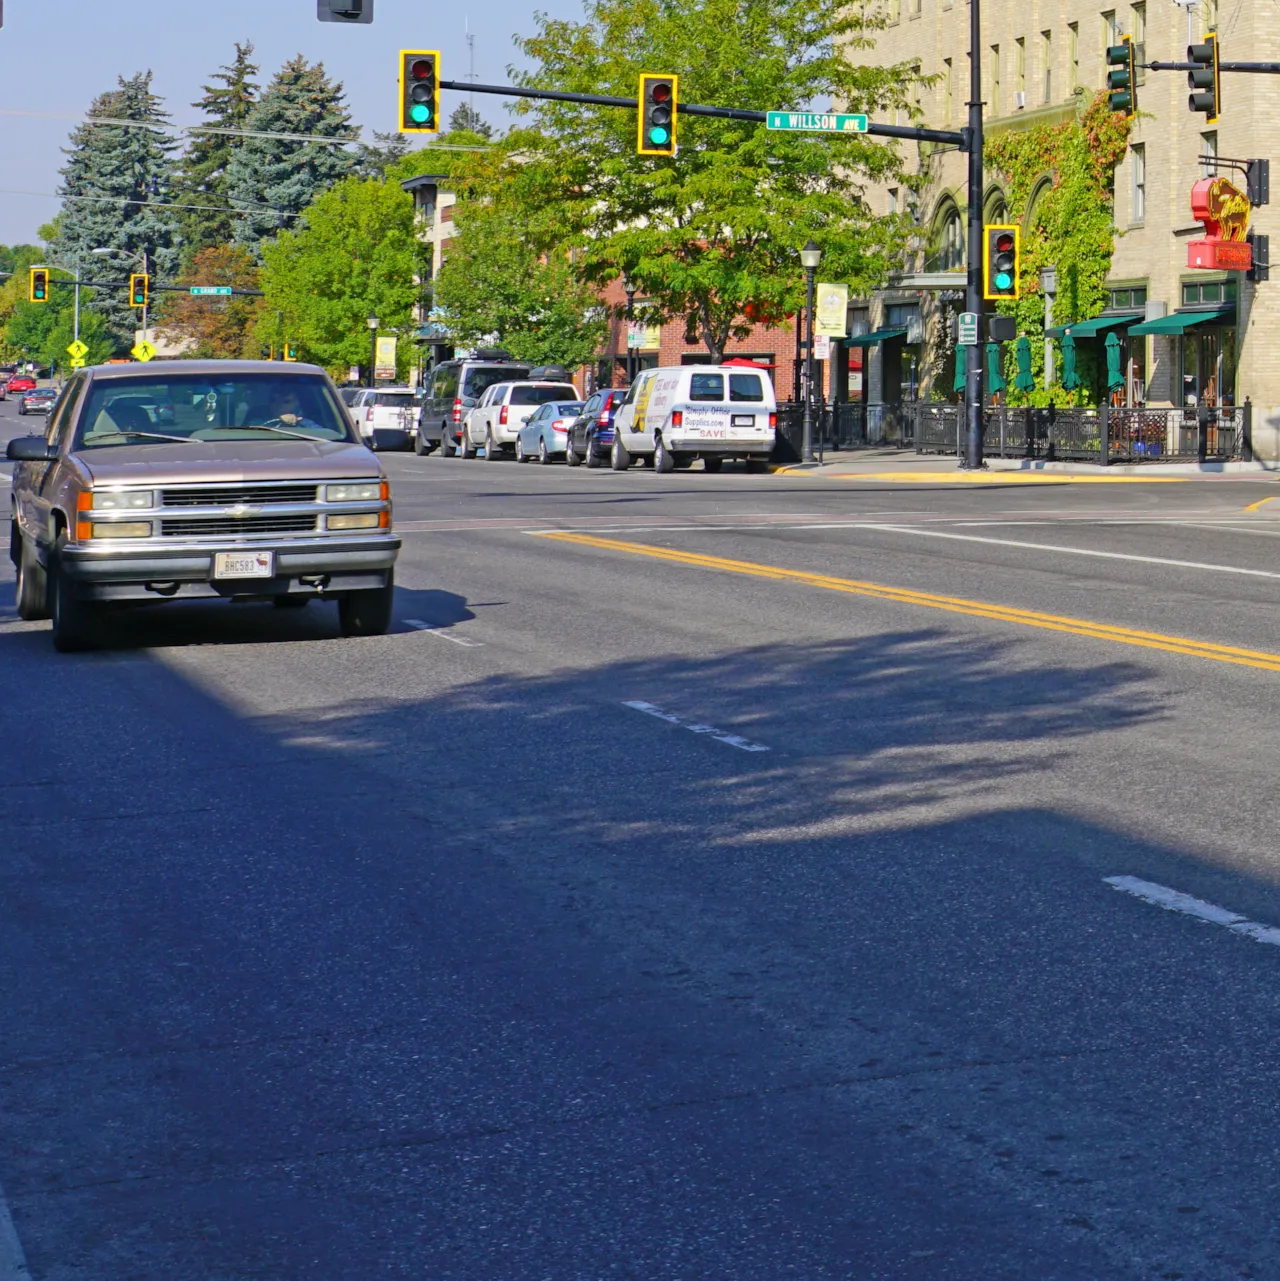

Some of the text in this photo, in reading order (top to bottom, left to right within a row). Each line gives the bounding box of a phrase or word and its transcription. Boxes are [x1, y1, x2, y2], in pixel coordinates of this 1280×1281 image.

[774, 114, 860, 130] N WILLSON AVE
[700, 430, 725, 438] SAVE
